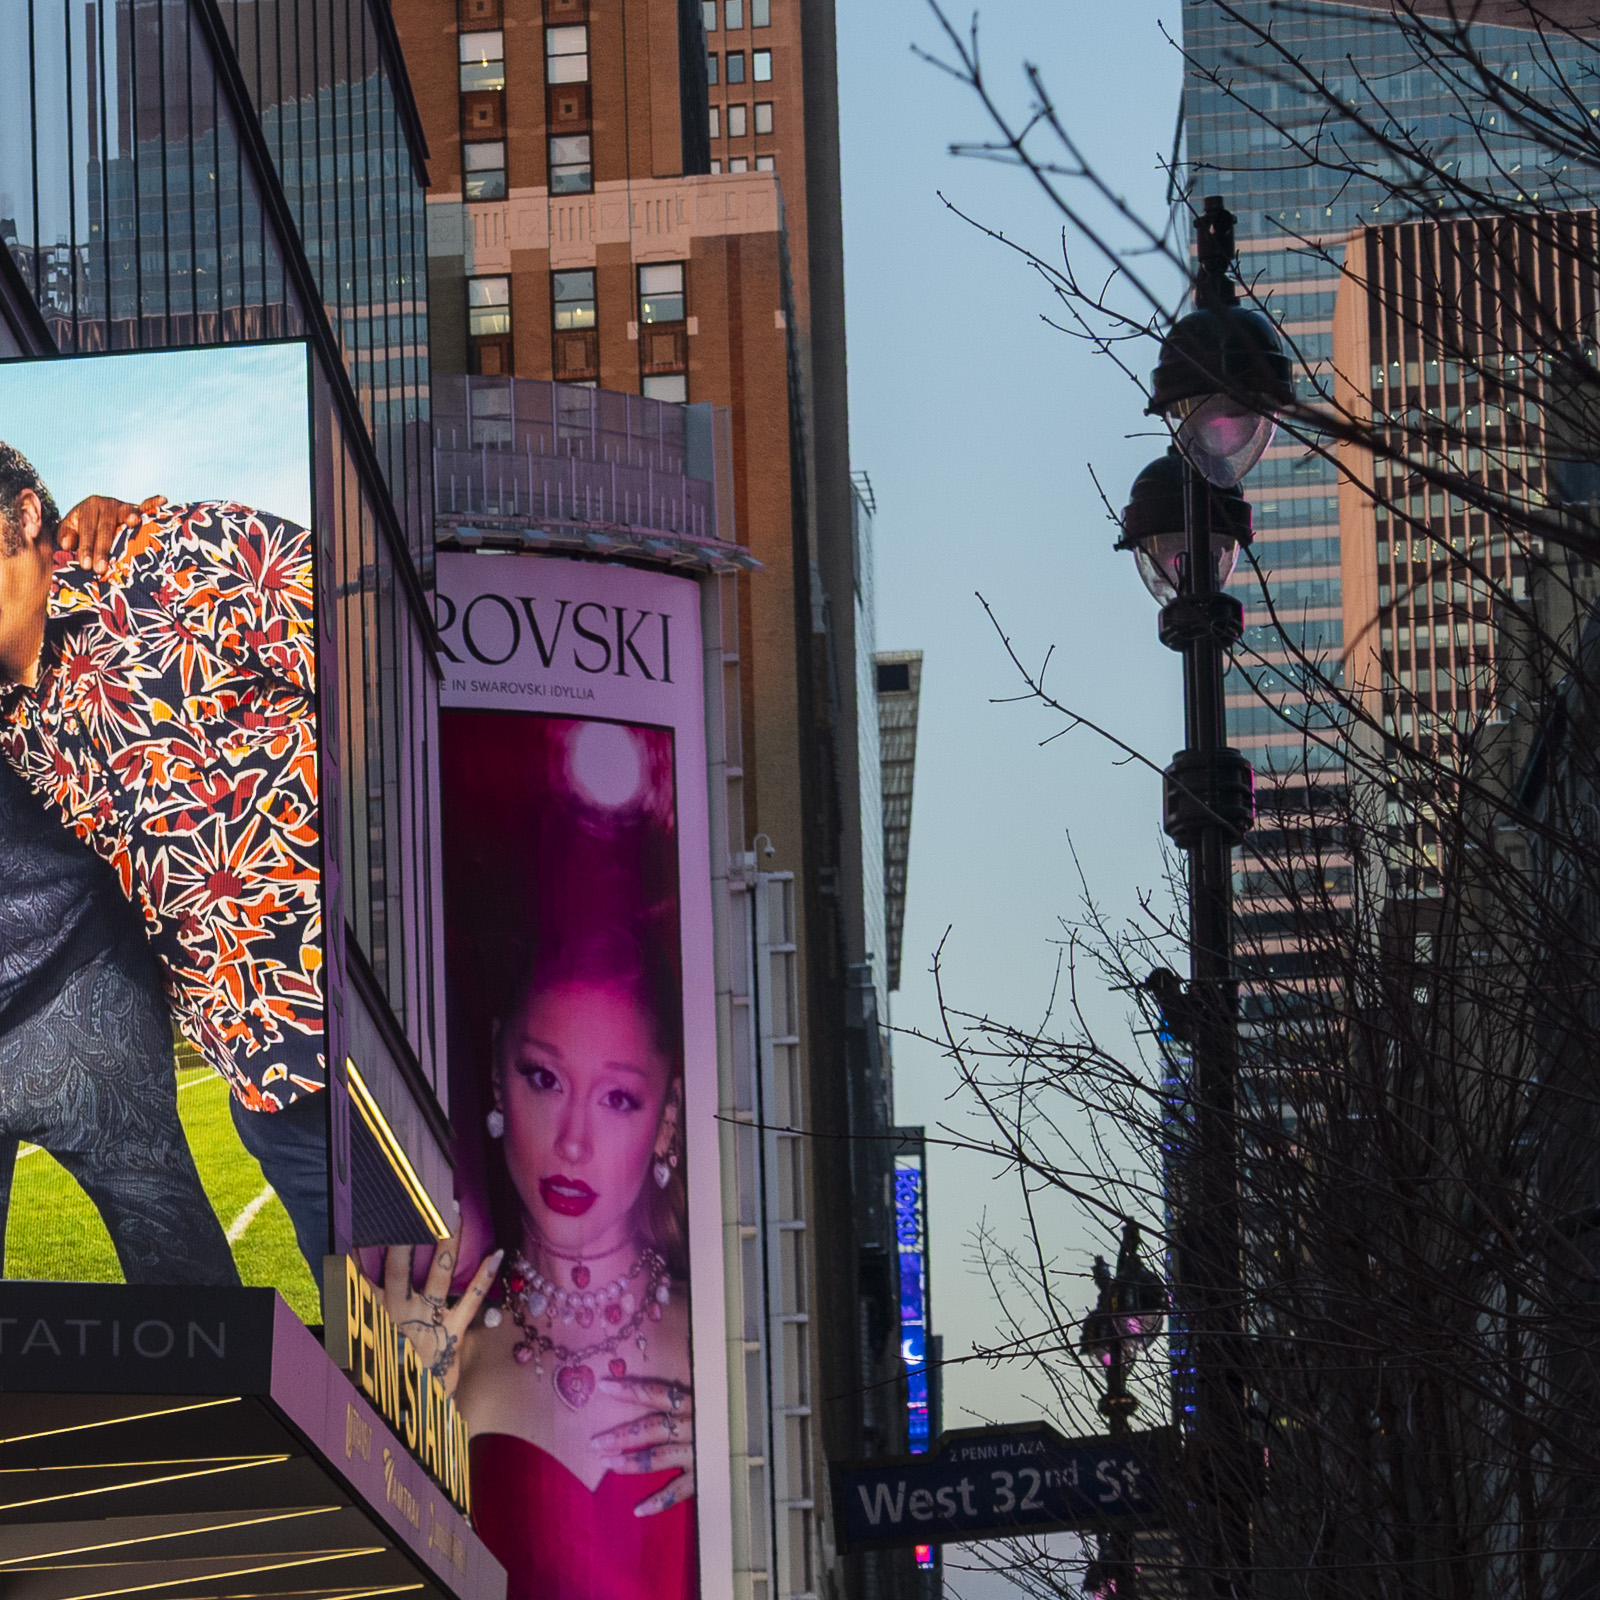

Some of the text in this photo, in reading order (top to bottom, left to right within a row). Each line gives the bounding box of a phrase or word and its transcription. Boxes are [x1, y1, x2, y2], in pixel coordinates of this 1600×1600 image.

[452, 680, 466, 691] IN
[471, 680, 547, 696] SWAROVSKI
[550, 686, 595, 700] IDYLLIA
[346, 1253, 400, 1431] PENN
[404, 1338, 471, 1515] STATION
[950, 1448, 958, 1463] 2
[961, 1445, 998, 1460] PENN
[858, 1477, 977, 1525] West
[1095, 1459, 1141, 1502] St
